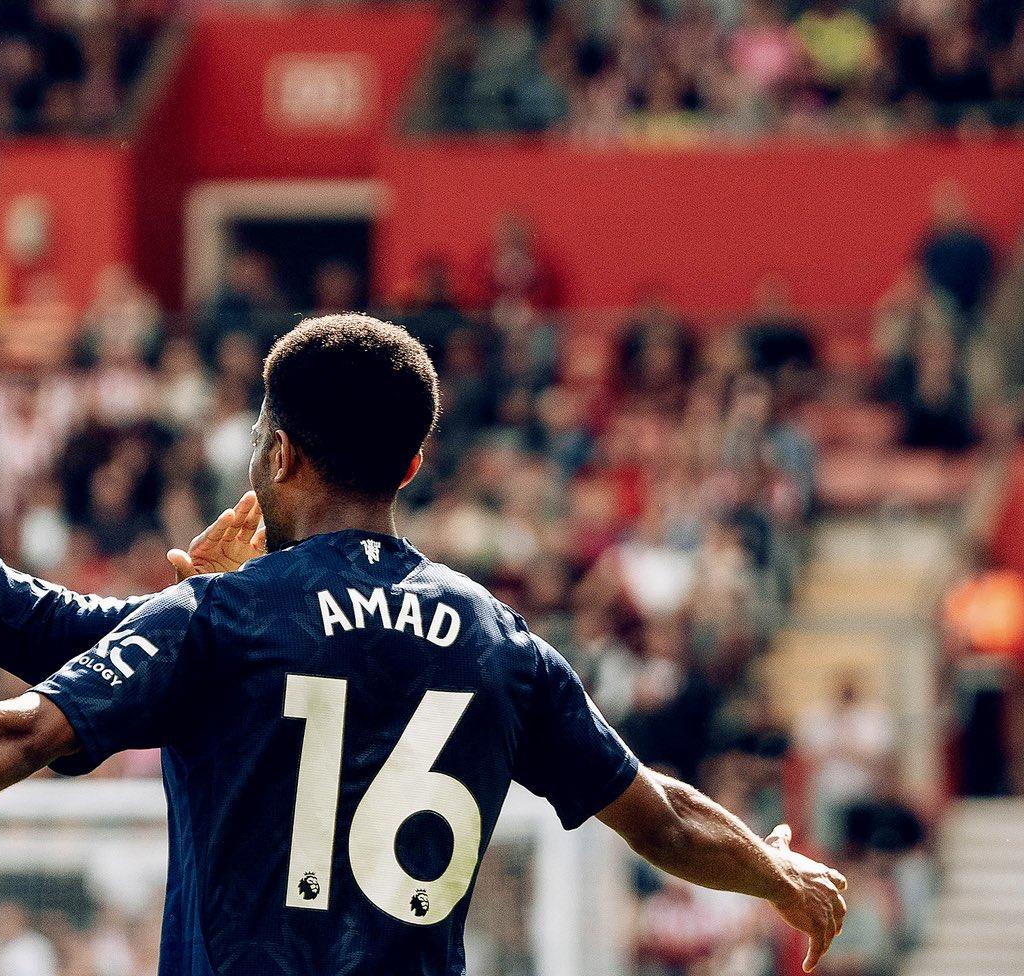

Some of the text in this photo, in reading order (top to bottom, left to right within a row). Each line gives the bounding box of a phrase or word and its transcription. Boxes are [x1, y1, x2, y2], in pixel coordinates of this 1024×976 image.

[317, 587, 461, 647] AMAD
[78, 656, 123, 687] OLOGY
[283, 674, 481, 925] 16
